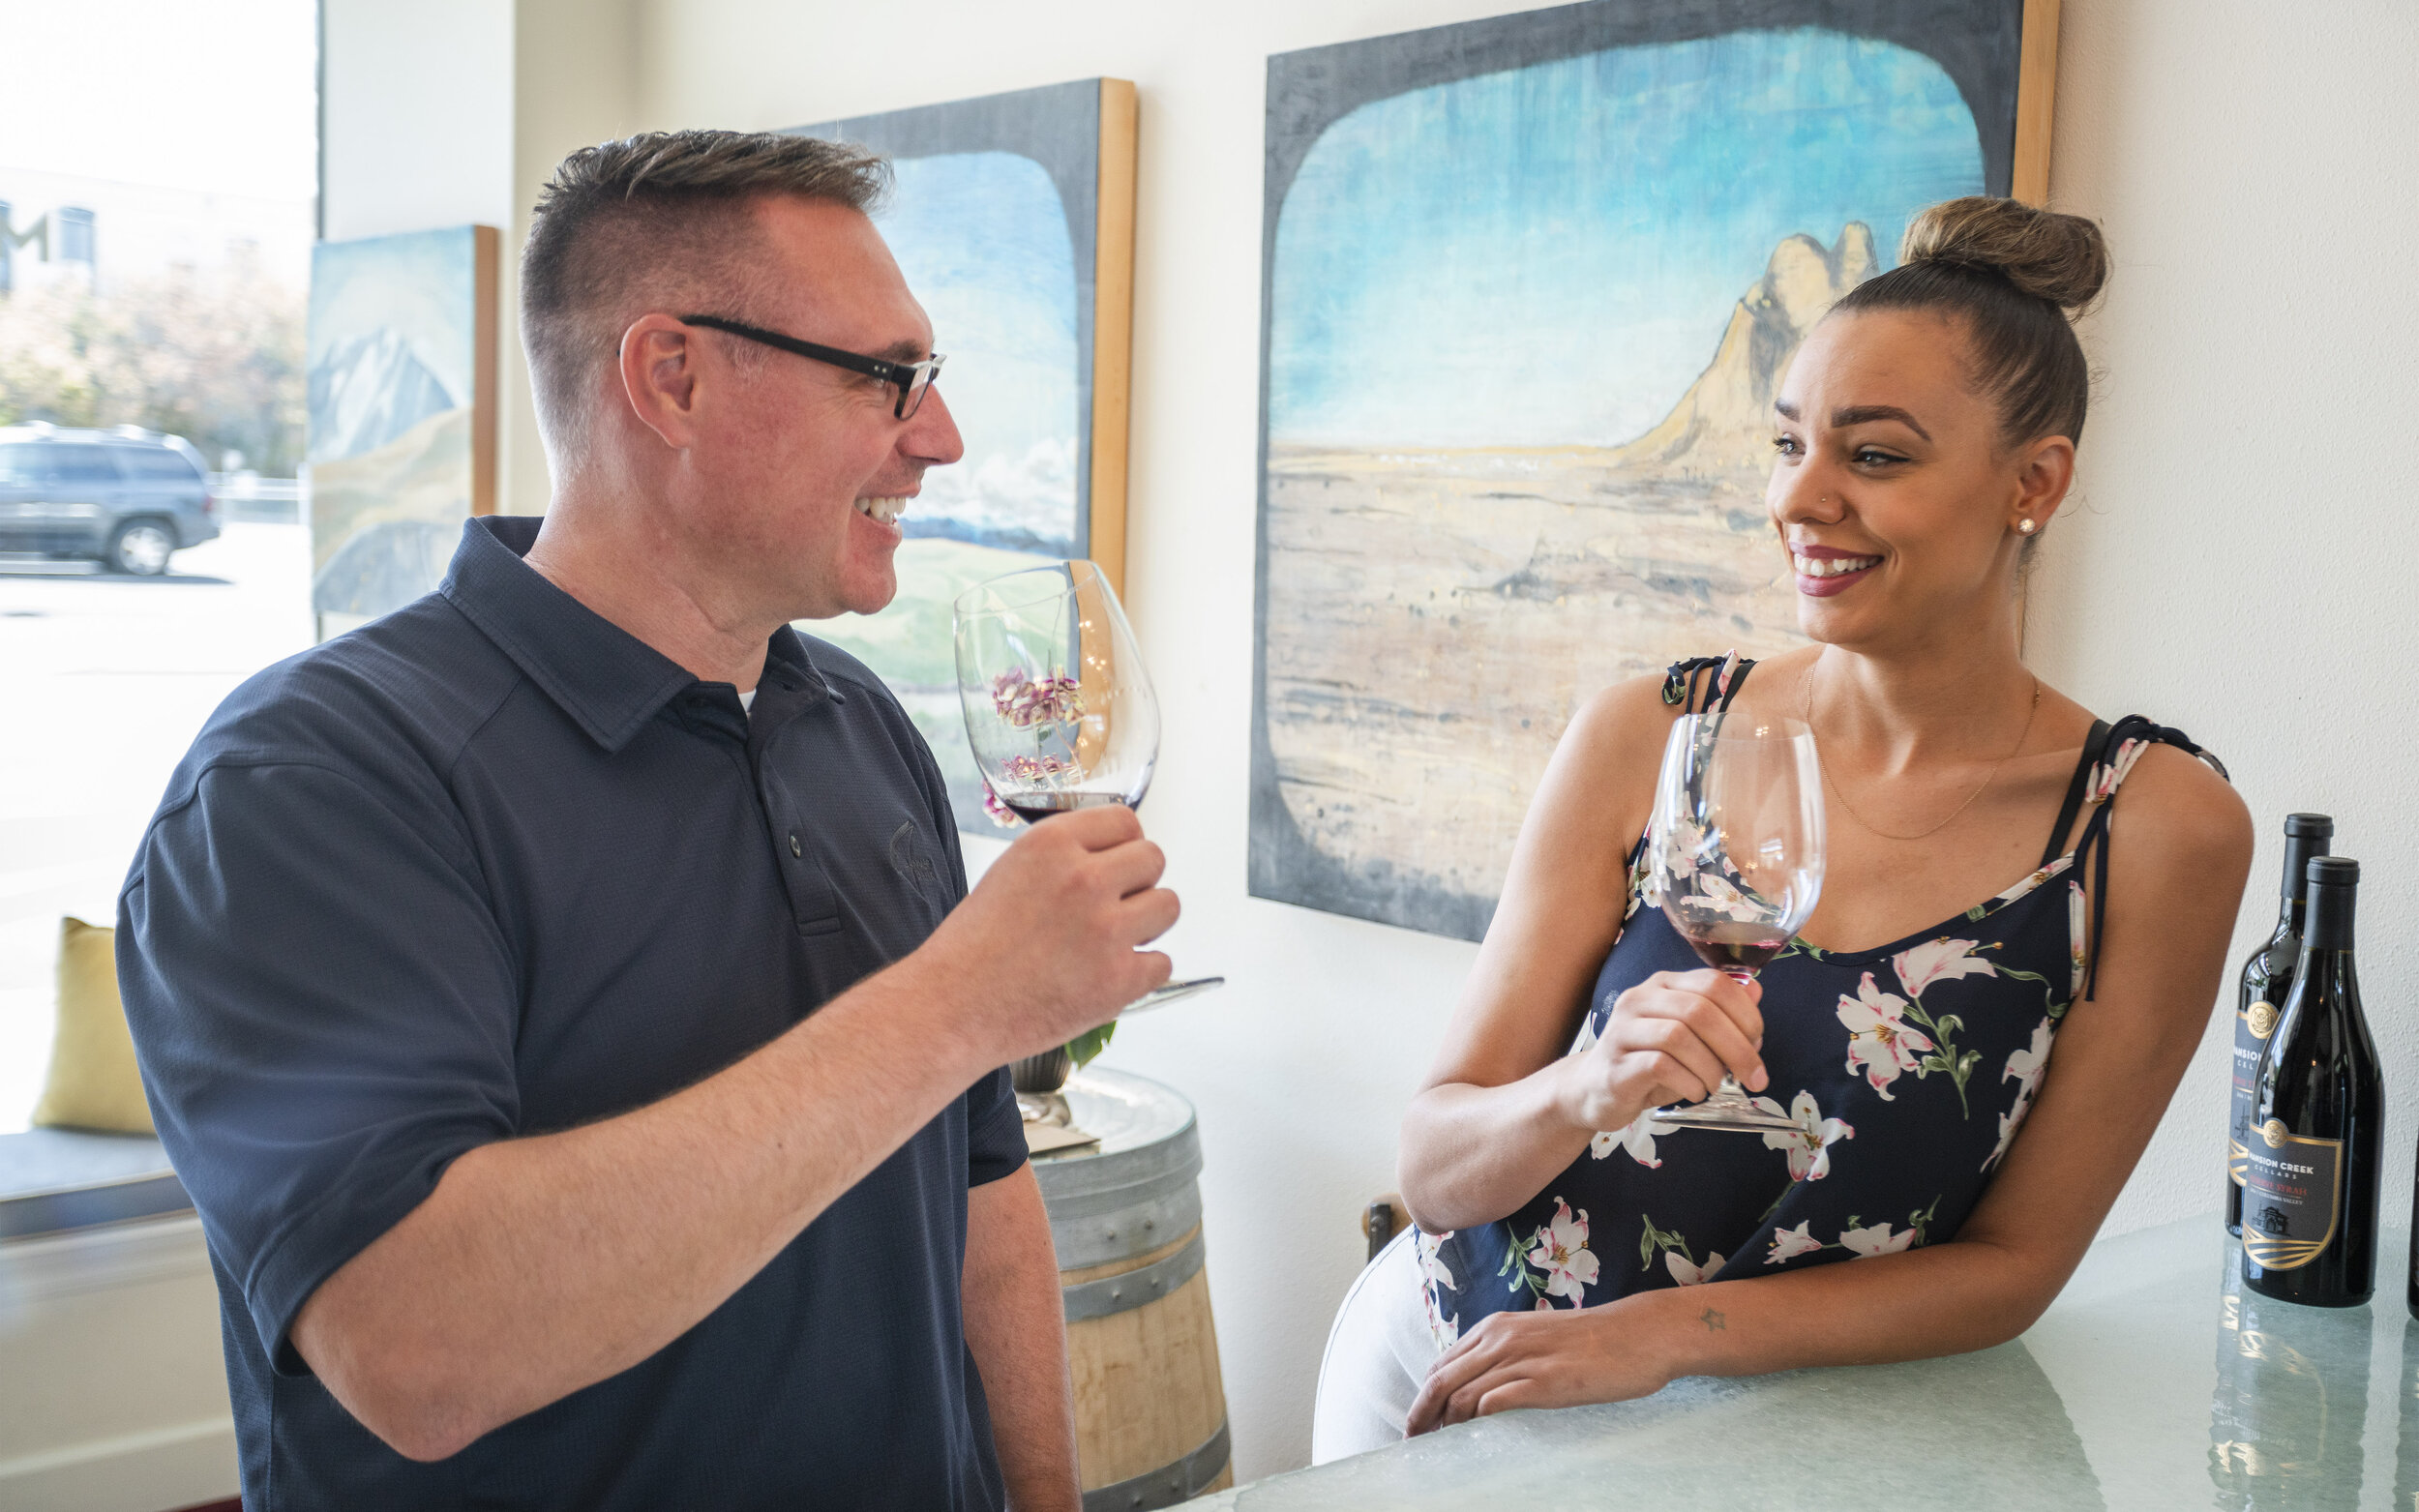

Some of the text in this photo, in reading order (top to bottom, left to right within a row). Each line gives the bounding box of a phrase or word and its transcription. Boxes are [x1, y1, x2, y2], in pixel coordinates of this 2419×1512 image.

[2249, 1151, 2314, 1174] MANSION CREEK
[2255, 1164, 2297, 1179] CELLARS
